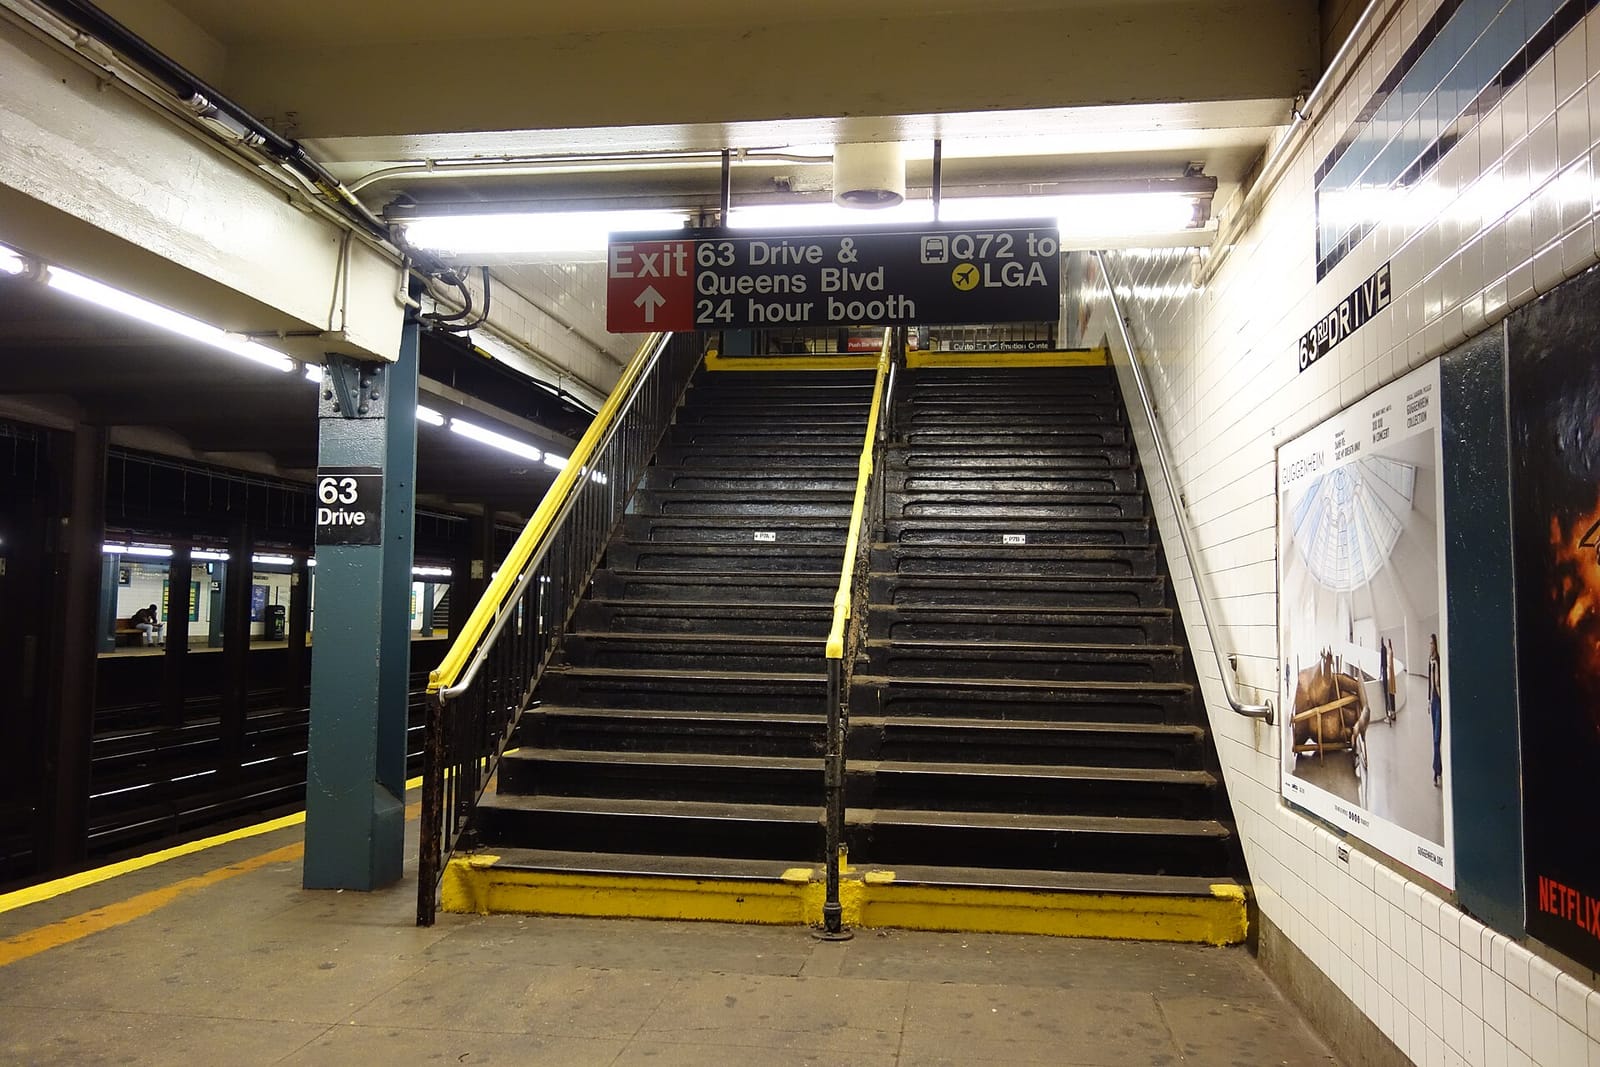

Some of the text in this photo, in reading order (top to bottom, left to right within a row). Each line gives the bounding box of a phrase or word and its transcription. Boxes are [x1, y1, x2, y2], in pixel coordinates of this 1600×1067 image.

[696, 237, 858, 267] 63 Drive &
[951, 232, 1057, 260] Q72 to
[609, 244, 688, 279] Exit
[984, 261, 1048, 288] LGA
[696, 266, 885, 296] Queens Blvd
[696, 294, 916, 324] 24 hour booth
[1328, 264, 1390, 348] DRIVE
[318, 477, 358, 505] 63
[317, 508, 366, 526] Drive
[1538, 875, 1600, 942] NETFLIX
